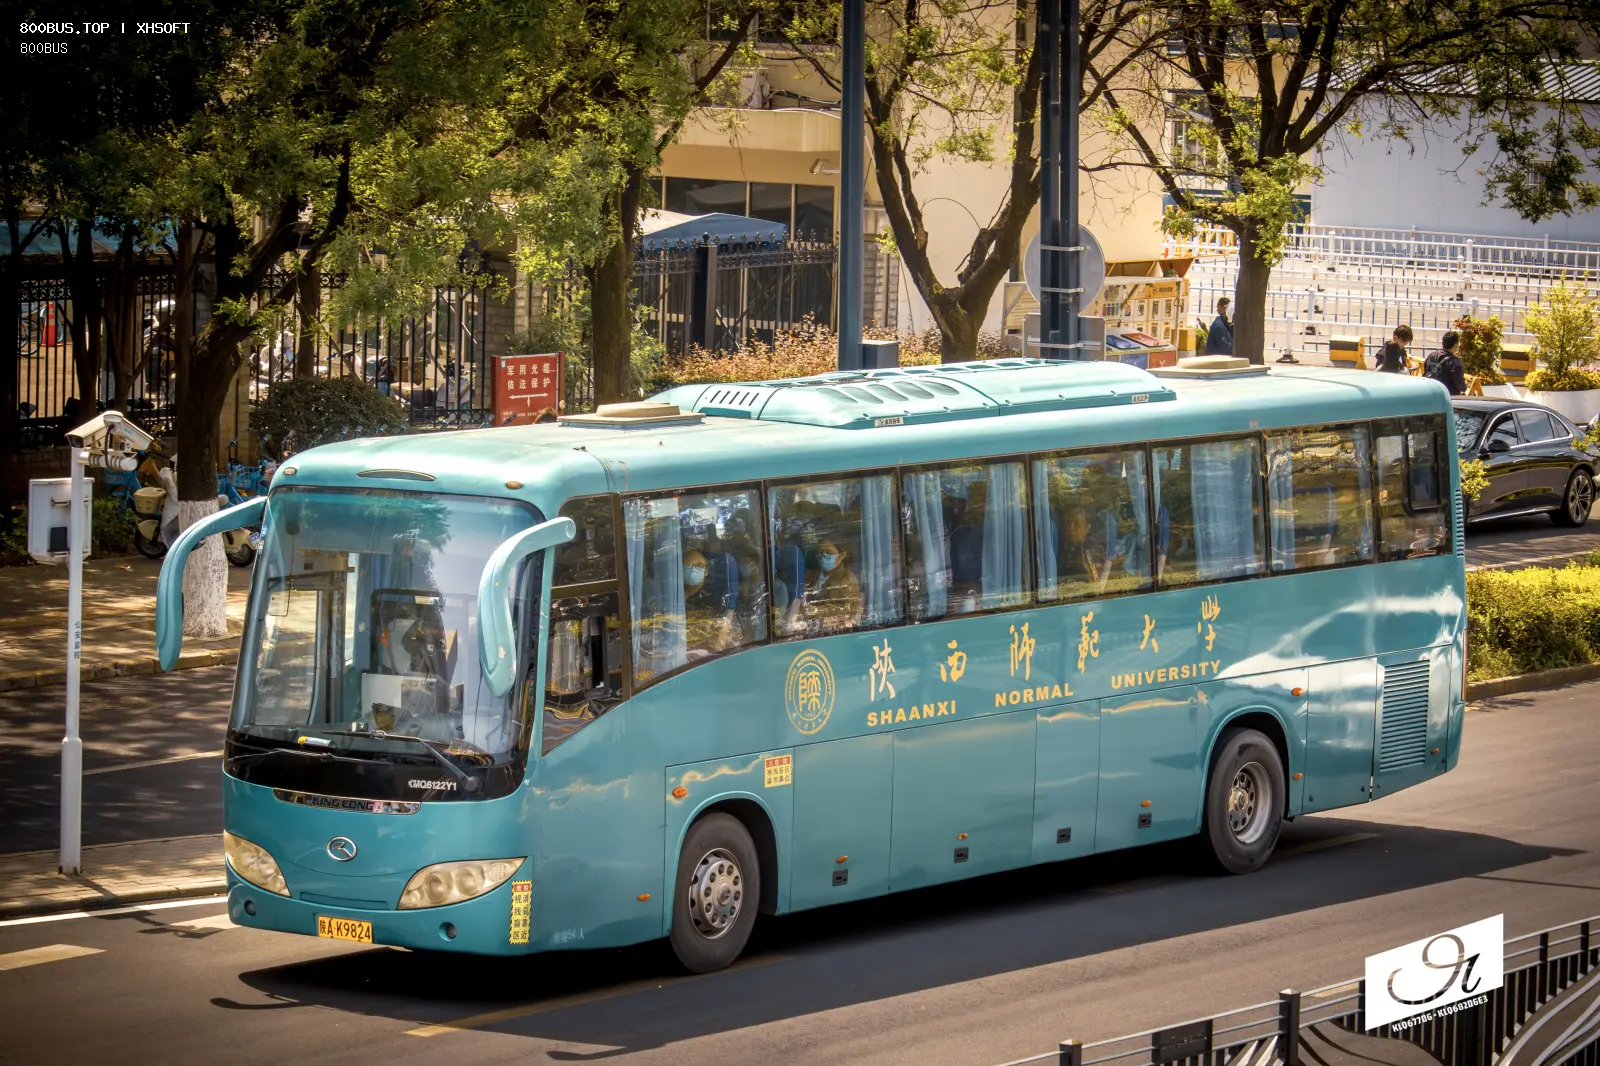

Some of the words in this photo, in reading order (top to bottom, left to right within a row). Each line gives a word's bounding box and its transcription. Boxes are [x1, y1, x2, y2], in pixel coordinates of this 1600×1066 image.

[507, 363, 551, 376] 军用光缆
[507, 377, 551, 390] 依法保护
[866, 700, 957, 727] SHAANXI
[995, 683, 1075, 707] NORMAL
[1110, 660, 1222, 690] UNIVERSITY
[312, 796, 340, 808] KING
[342, 799, 374, 812] LONG
